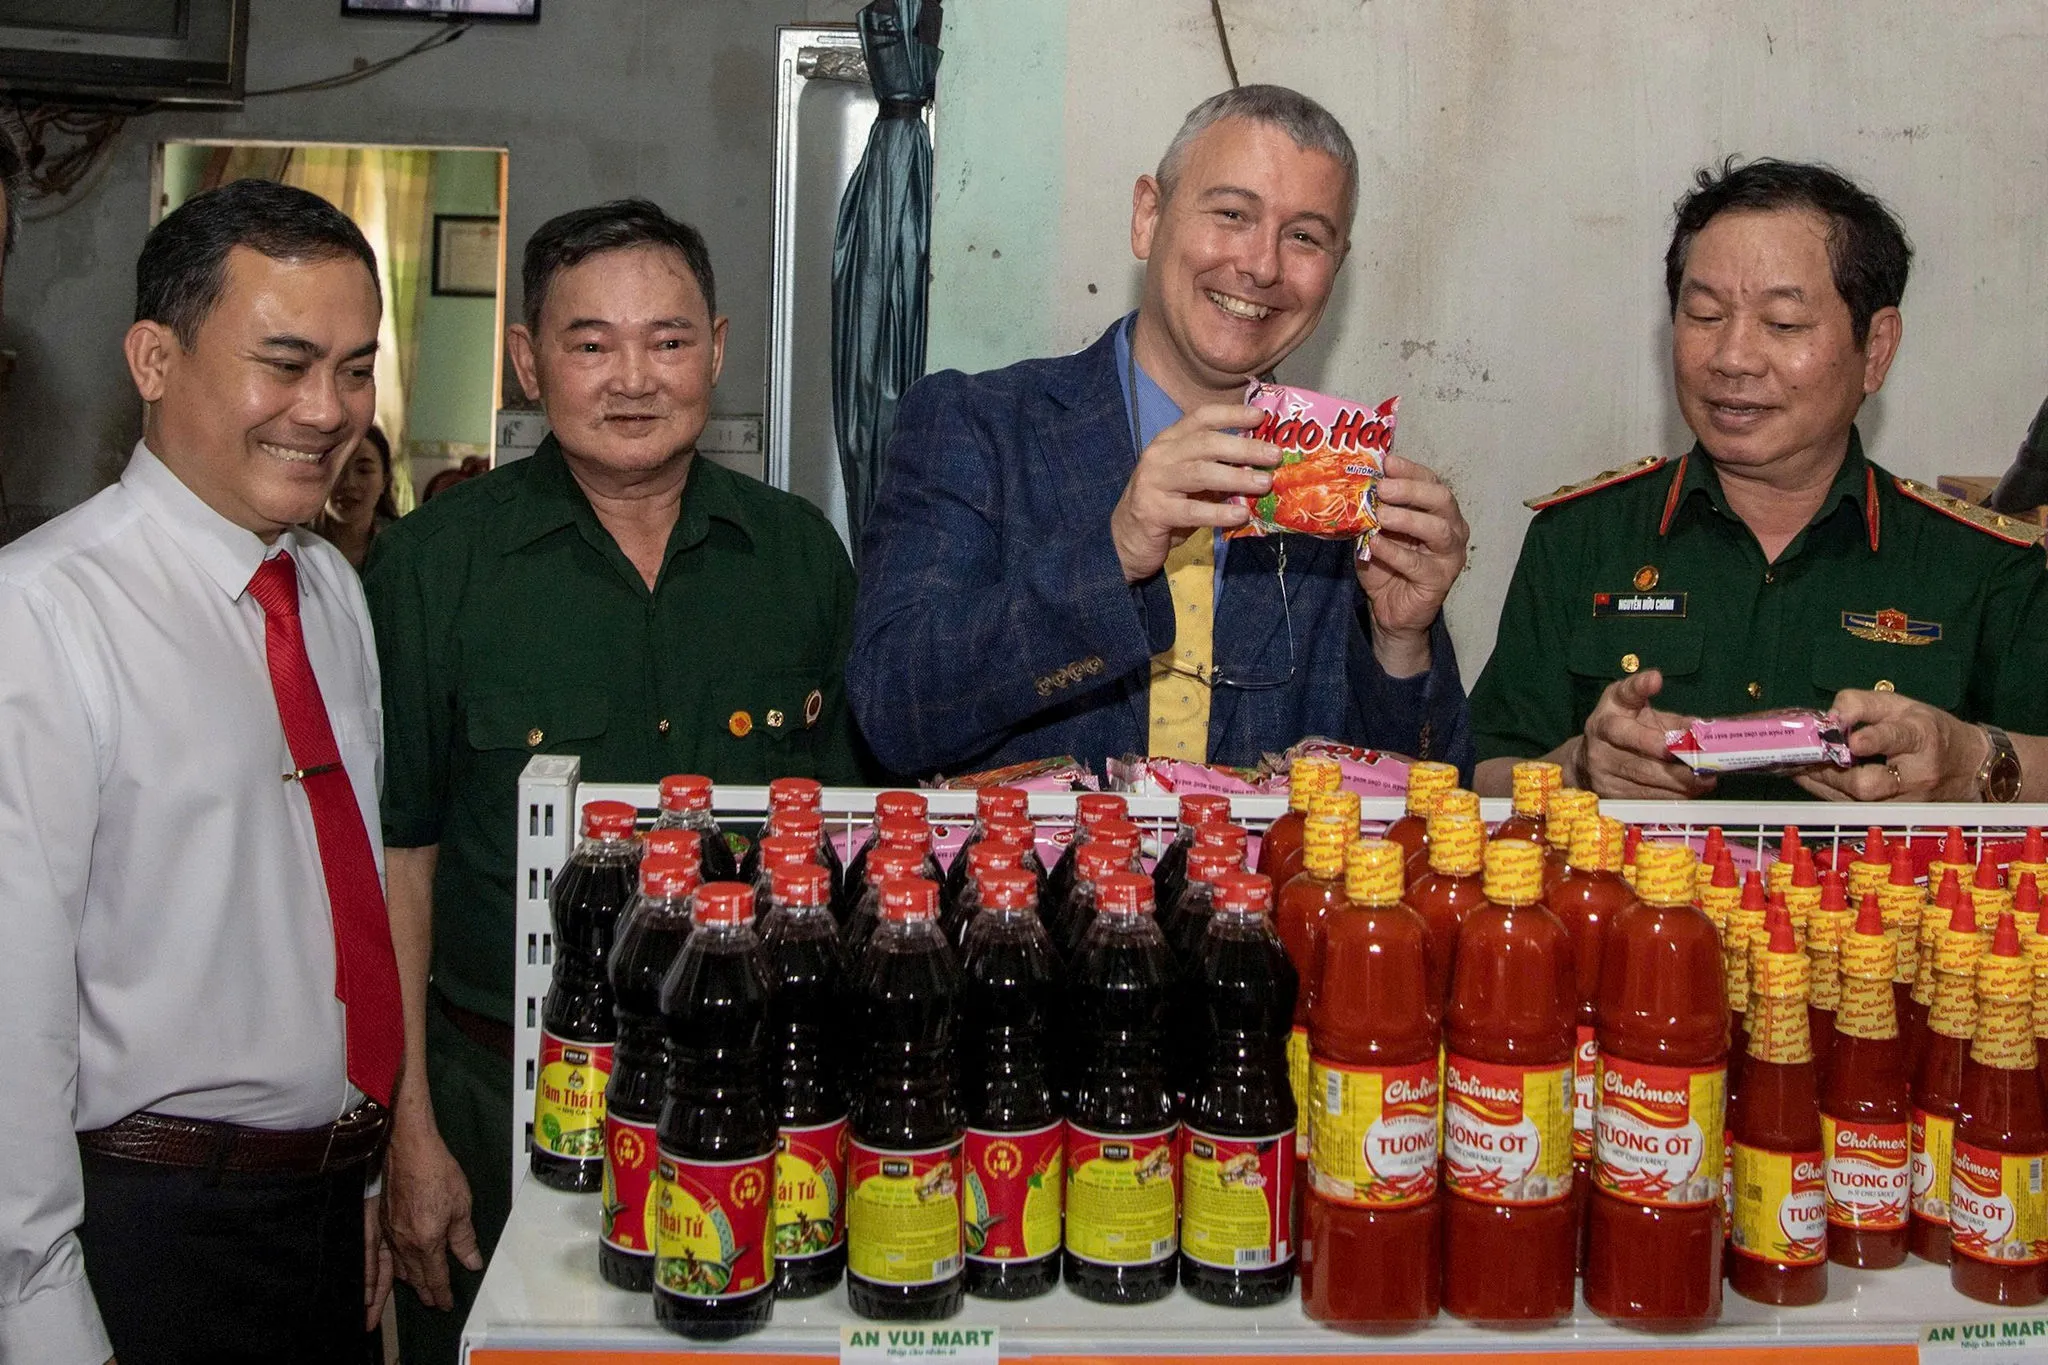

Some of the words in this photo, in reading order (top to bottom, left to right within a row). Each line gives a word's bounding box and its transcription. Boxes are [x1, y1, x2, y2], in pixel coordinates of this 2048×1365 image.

[1447, 1066, 1521, 1104] Cholimex
[1604, 1070, 1687, 1106] Cholimex
[564, 1090, 593, 1109] Thái
[598, 1092, 604, 1109] T
[1837, 1130, 1906, 1150] Cholimex
[778, 1180, 793, 1202] ái
[850, 1330, 879, 1346] AN
[888, 1330, 924, 1346] VUI
[932, 1330, 994, 1346] MART
[1928, 1327, 1955, 1342] AN
[1962, 1324, 1995, 1339] VUI
[2002, 1320, 2048, 1338] MAR
